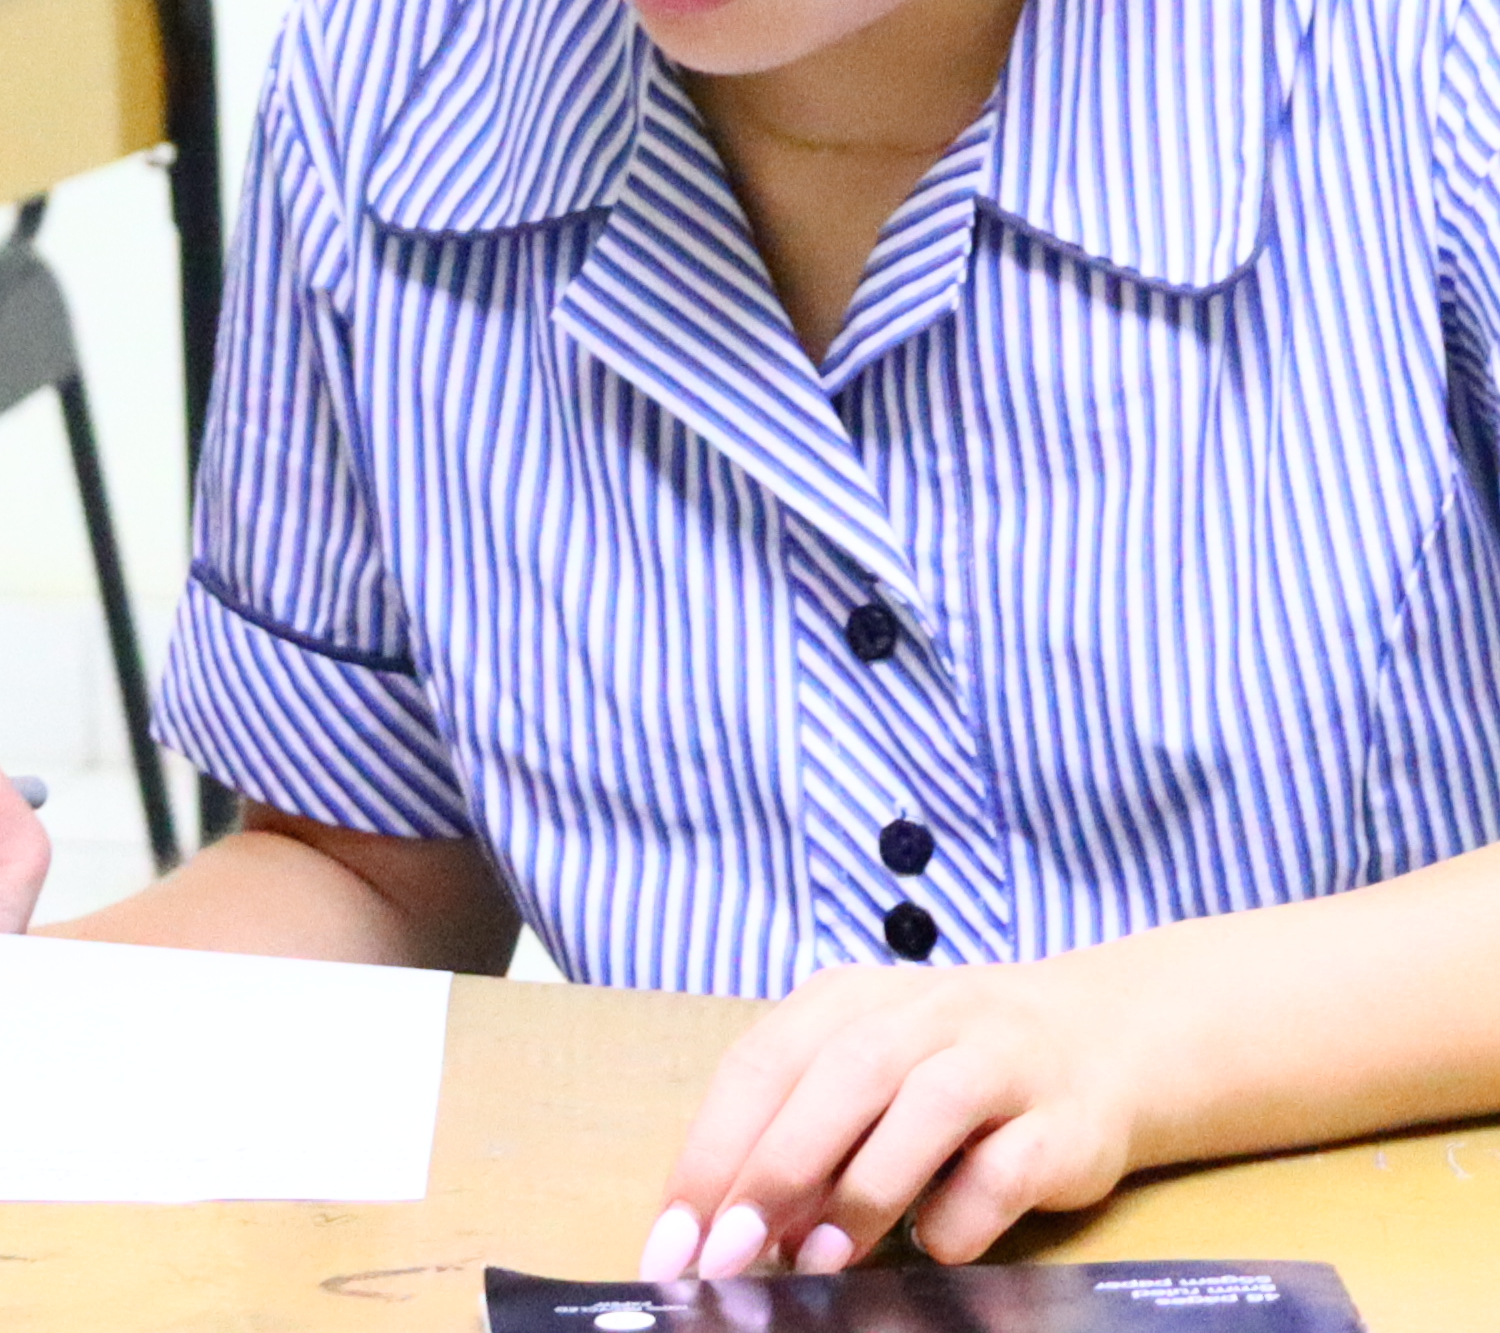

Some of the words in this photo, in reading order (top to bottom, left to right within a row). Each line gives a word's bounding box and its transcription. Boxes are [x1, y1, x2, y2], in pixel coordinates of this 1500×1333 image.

[1094, 1277, 1172, 1290] paper
[1131, 1287, 1199, 1300] ruled
[1155, 1293, 1238, 1306] pages
